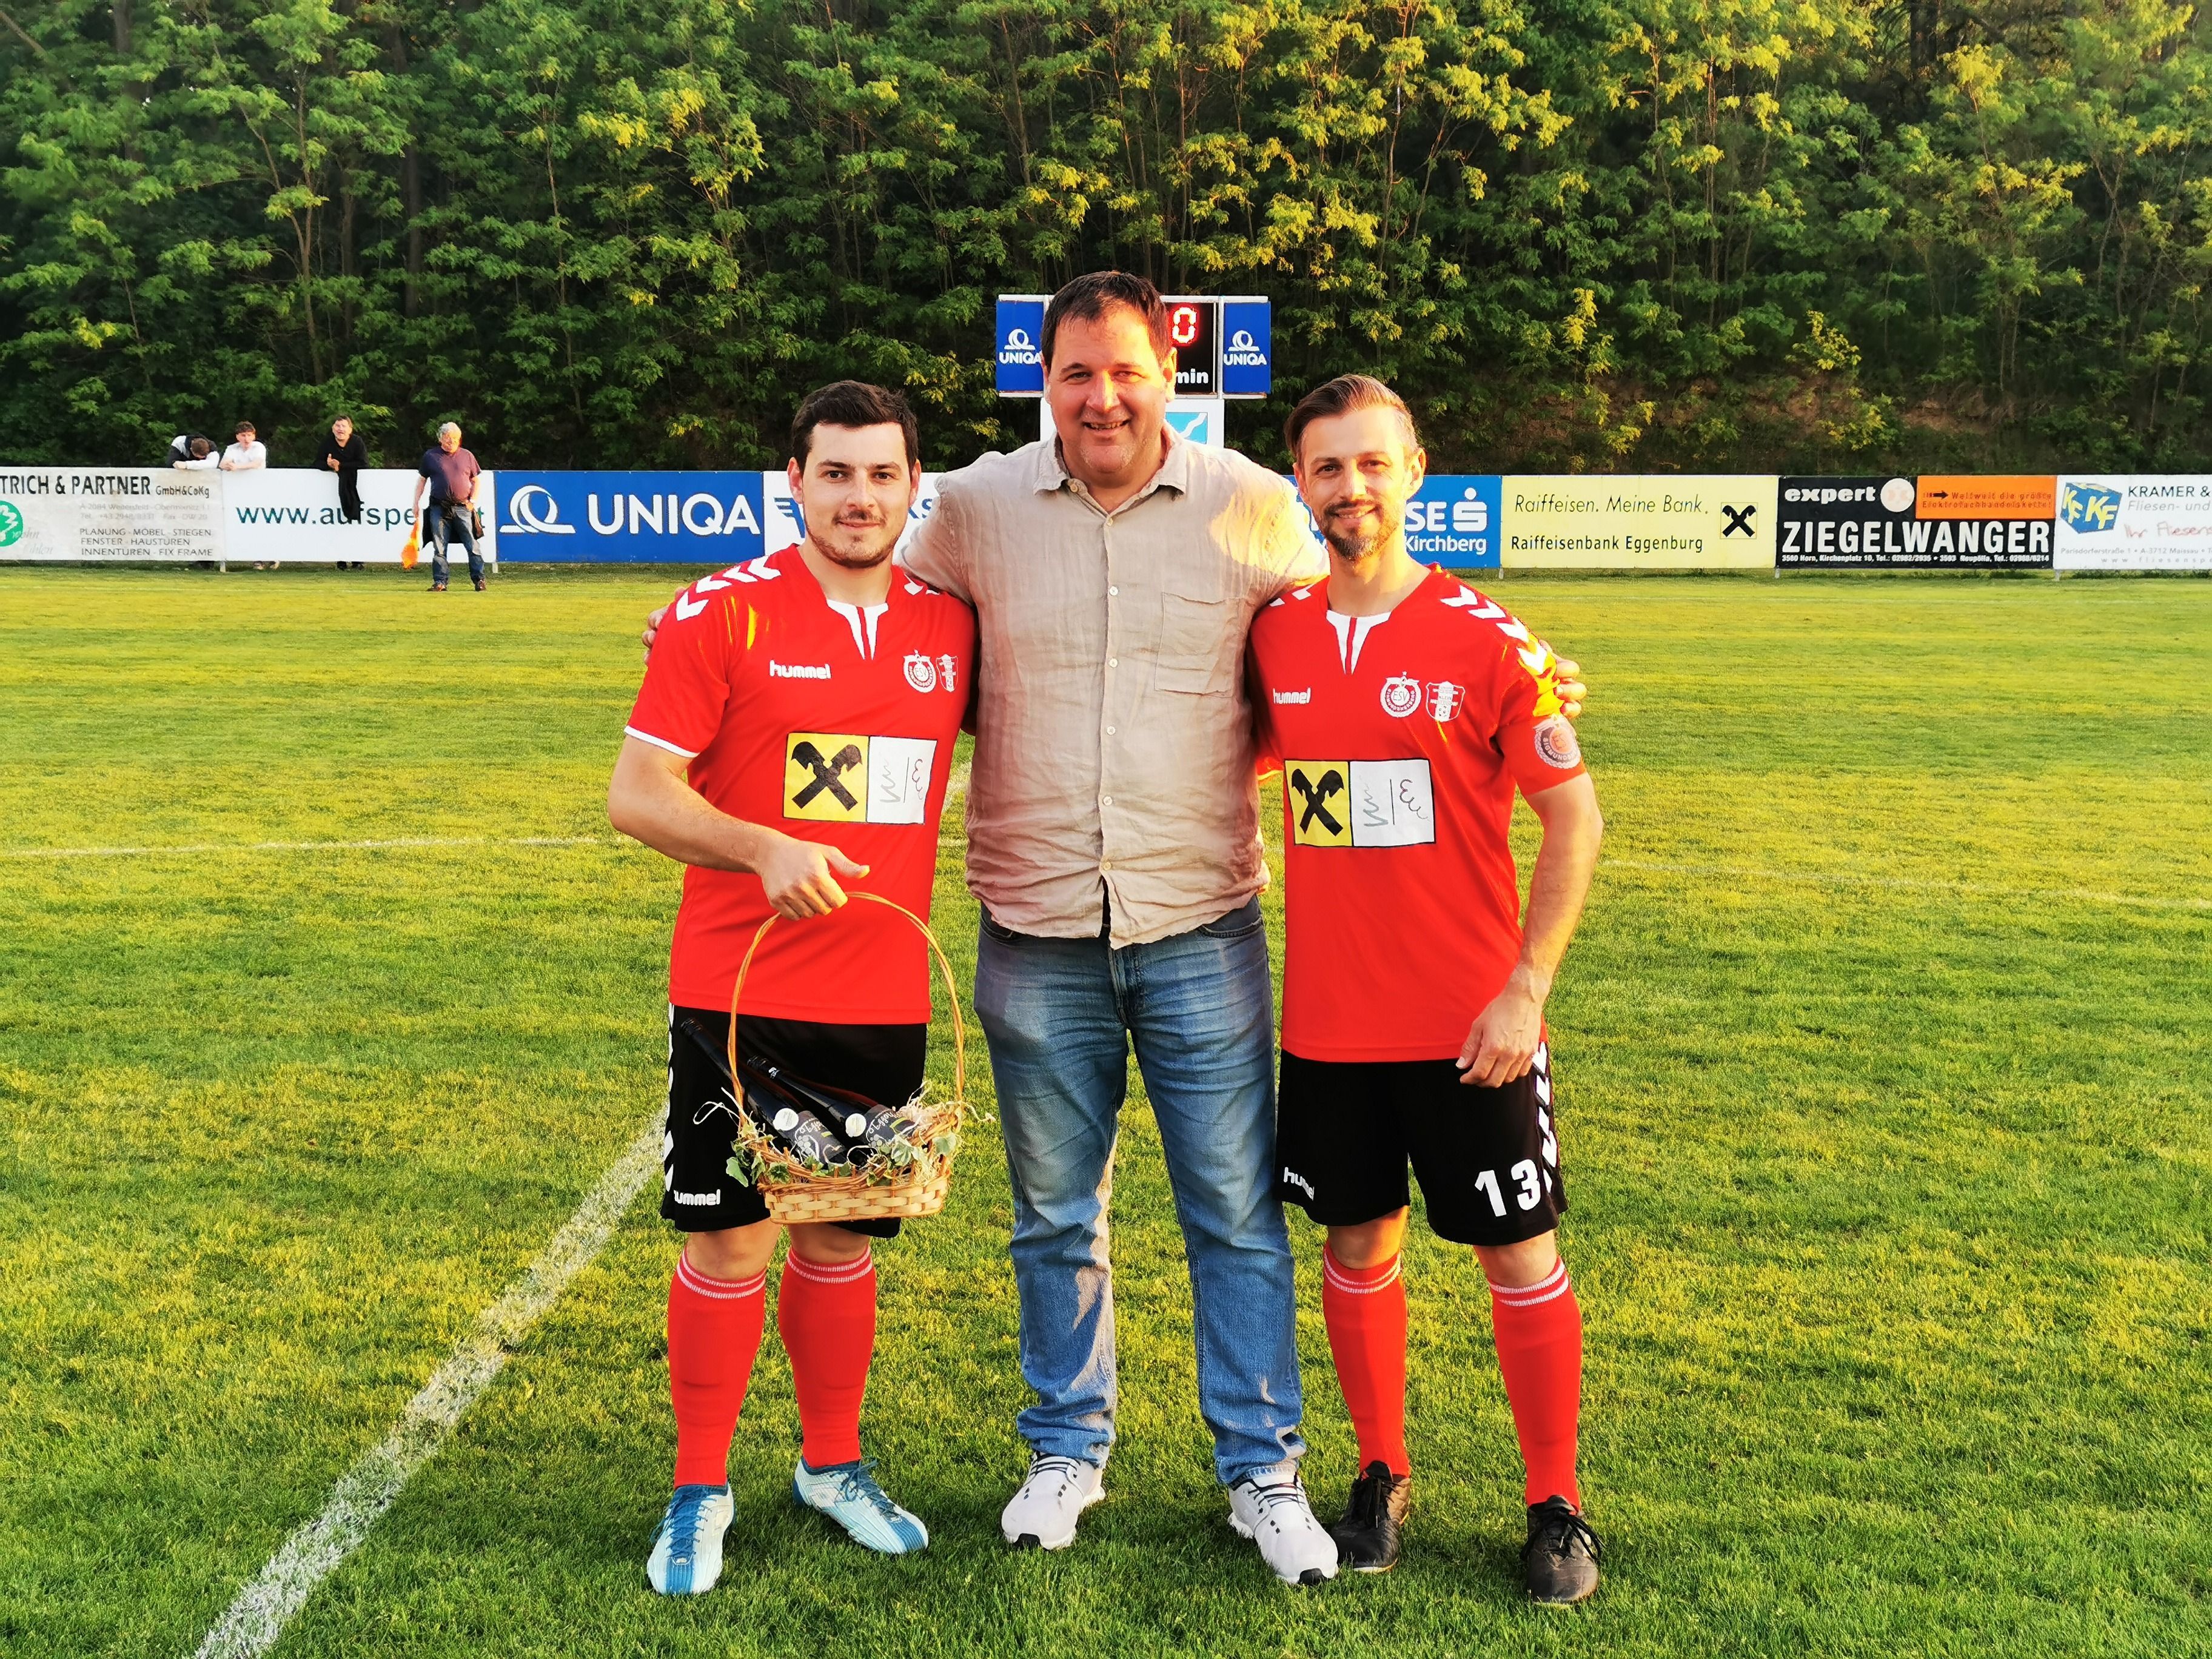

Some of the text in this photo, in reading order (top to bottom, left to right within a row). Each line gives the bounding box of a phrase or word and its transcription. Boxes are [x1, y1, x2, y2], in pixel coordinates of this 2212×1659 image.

[1172, 307, 1197, 343] 0
[999, 352, 1041, 364] UNIQA
[1224, 353, 1267, 366] UNIQA
[1176, 368, 1208, 383] min
[0, 475, 49, 494] TRICH
[55, 475, 65, 494] &
[72, 475, 150, 495] PARTNER
[2128, 486, 2211, 497] KRAMER &
[1515, 494, 1708, 514] Raiffeisen. Meine Bank.
[1785, 486, 1875, 504] expert
[588, 493, 760, 535] UNIQA
[2128, 500, 2211, 511] Fliesen- und
[1406, 535, 1486, 555] Kirchberg
[1511, 535, 1703, 553] Raiffeisenbank Eggenburg
[1782, 521, 2049, 552] ZIEGELWANGER
[769, 659, 831, 680] hummel
[1272, 687, 1311, 704] hummel
[1393, 691, 1408, 702] ESV
[1474, 1159, 1541, 1217] 13
